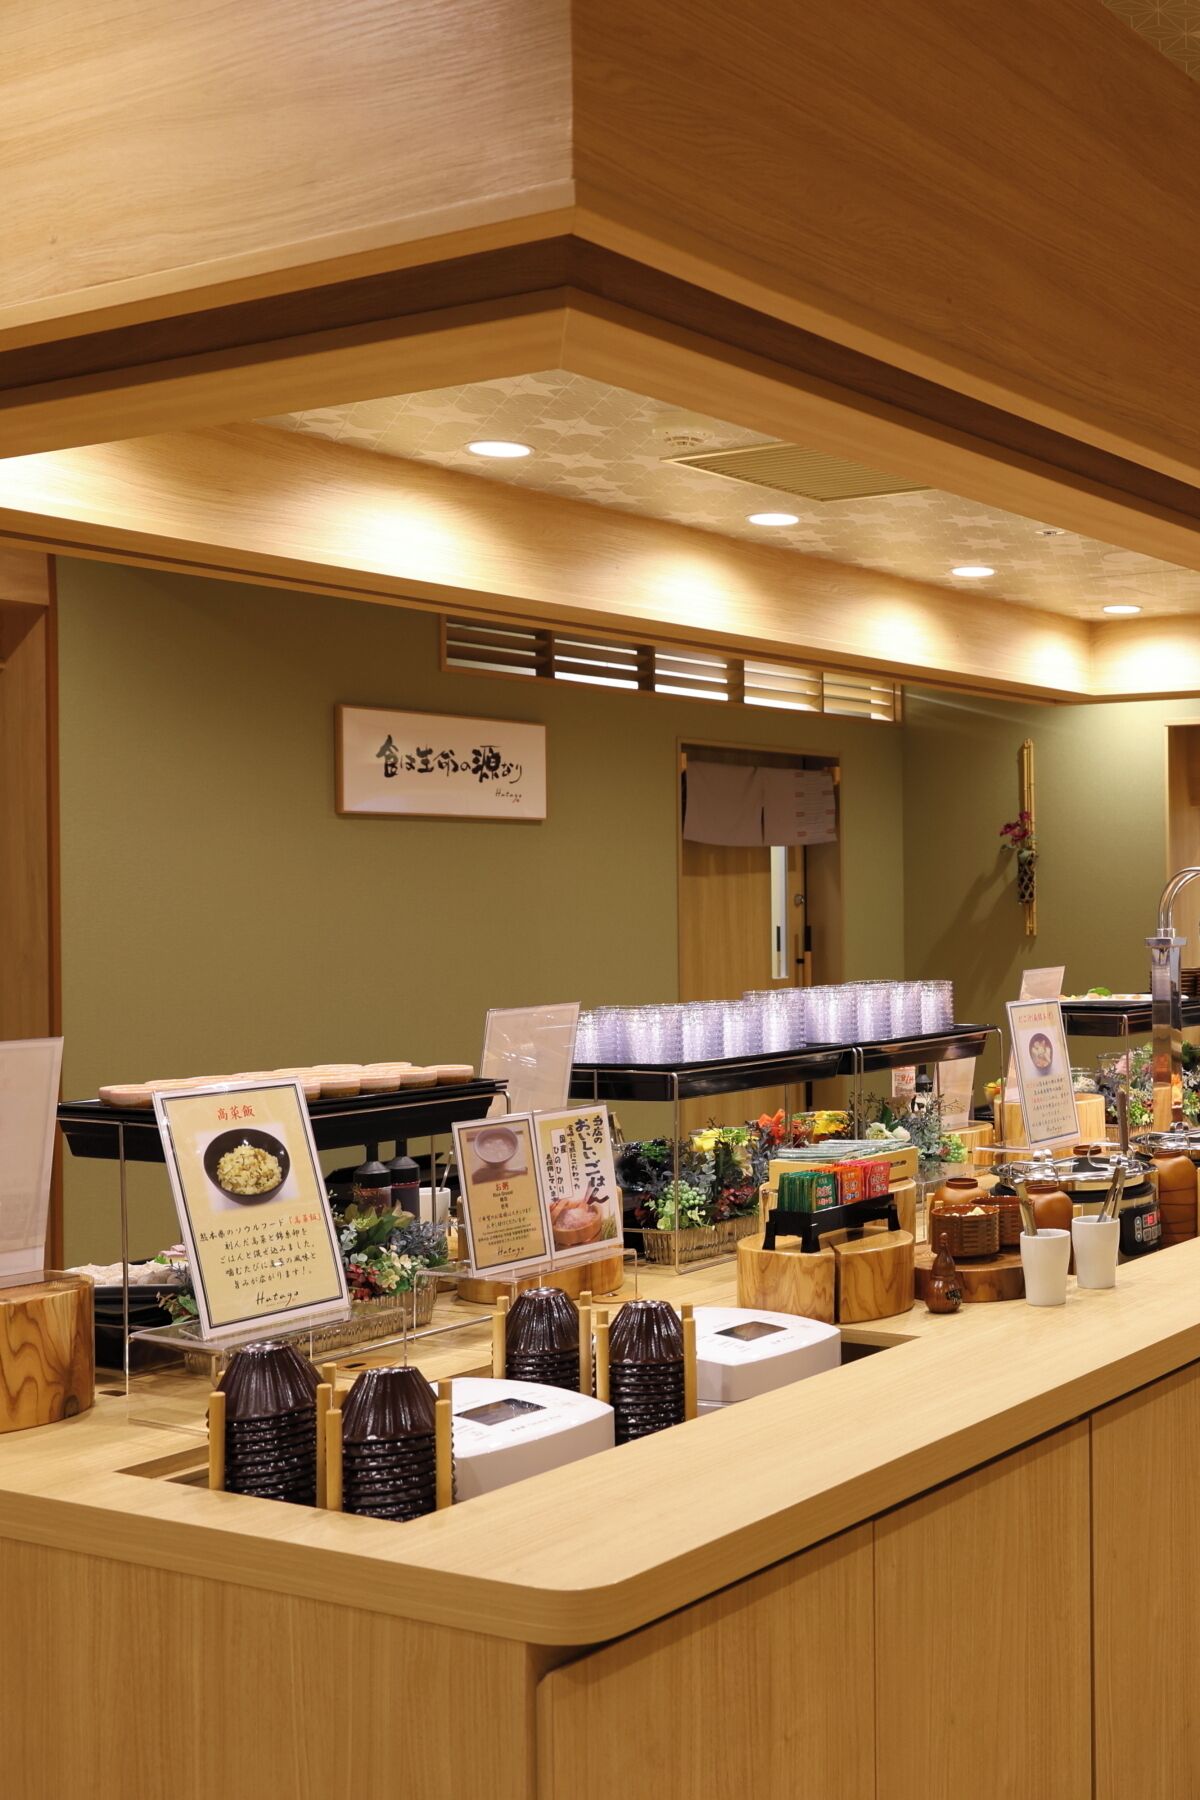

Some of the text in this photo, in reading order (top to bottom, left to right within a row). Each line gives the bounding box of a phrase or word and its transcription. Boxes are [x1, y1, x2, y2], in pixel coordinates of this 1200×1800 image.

[376, 734, 523, 784] 食は生命の源なり
[217, 1105, 256, 1121] 高菜飯
[575, 1118, 610, 1205] おいしいごはん
[256, 1290, 299, 1307] Hatago
